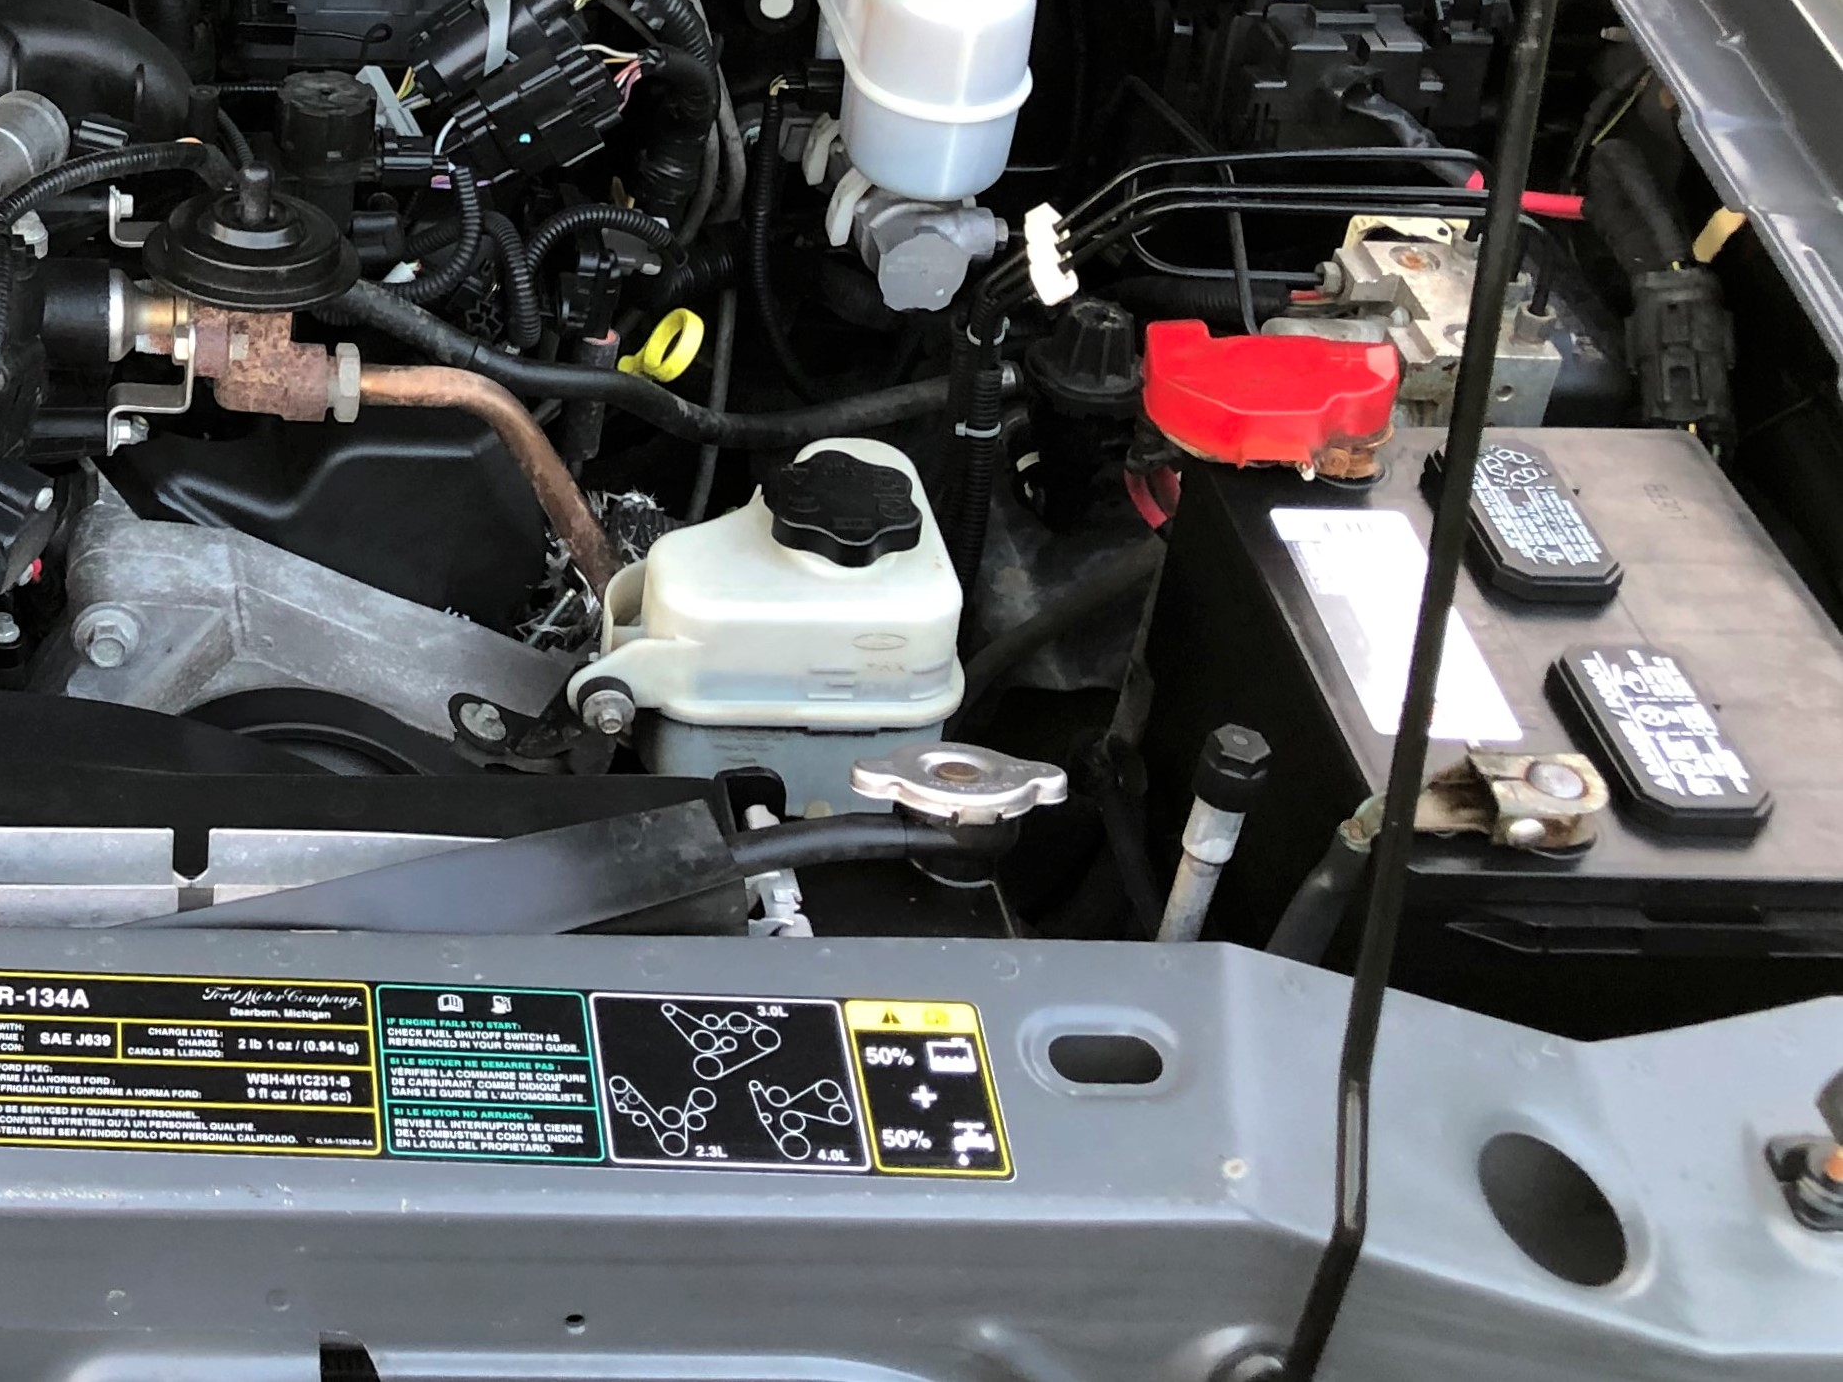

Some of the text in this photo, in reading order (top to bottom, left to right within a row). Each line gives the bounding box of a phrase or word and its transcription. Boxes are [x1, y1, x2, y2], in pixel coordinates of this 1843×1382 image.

[202, 987, 362, 1010] Ford Motor Company
[230, 1007, 331, 1021] Dearborn, Michigan
[757, 1004, 789, 1018] 3.0L
[399, 1018, 437, 1027] ENGINE
[439, 1020, 467, 1028] FAILS
[470, 1021, 484, 1029] TO
[40, 1032, 111, 1047] SAE J639
[148, 1027, 223, 1038] CHARGE LEVEL:
[387, 1027, 560, 1043] CHECK FUEL SHUTOFF SWITCH AS
[0, 1043, 24, 1052] CON:
[177, 1038, 218, 1048] CHARGE
[249, 1039, 262, 1050] lb
[276, 1041, 293, 1051] oz
[303, 1040, 335, 1053] (0.94
[338, 1041, 359, 1055] kg)
[388, 1037, 580, 1053] REFERENCED IN YOUR OWNER GUIDE.
[127, 1047, 224, 1058] CARGA DE LLENADO:
[865, 1046, 915, 1067] 50%
[24, 1064, 53, 1073] SPEC:
[390, 1057, 400, 1065] SI
[464, 1060, 478, 1068] NE
[534, 1062, 555, 1071] PAS
[32, 1075, 45, 1083] LA
[46, 1075, 81, 1085] NORME
[83, 1076, 110, 1085] FORD
[439, 1069, 454, 1078] LA
[455, 1069, 517, 1081] COMMANDE
[518, 1072, 534, 1081] DE
[535, 1072, 587, 1083] COUPURE
[391, 1077, 406, 1086] DE
[477, 1080, 516, 1090] COMME
[69, 1086, 124, 1096] CONFORME
[134, 1088, 170, 1098] NORMA
[171, 1089, 202, 1099] FORD:
[258, 1087, 268, 1099] fl
[271, 1090, 287, 1100] oz
[330, 1090, 352, 1104] cc)
[392, 1087, 422, 1097] DANS
[423, 1088, 437, 1098] LE
[439, 1088, 472, 1099] GUIDE
[474, 1090, 489, 1099] DE
[5, 1105, 18, 1114] BE
[20, 1105, 69, 1115] SERVICED
[70, 1107, 84, 1116] BY
[86, 1107, 138, 1118] QUALIFIED
[406, 1108, 419, 1116] LE
[422, 1109, 460, 1117] MOTOR
[462, 1110, 478, 1118] NO
[394, 1118, 583, 1134] REVISE EL INTERRUPTOR DE CIERRE
[29, 1126, 55, 1136] DEBE
[58, 1128, 78, 1137] SER
[79, 1128, 129, 1138] ATENDIDO
[130, 1130, 158, 1139] SOLO
[159, 1131, 181, 1140] POR
[182, 1132, 235, 1142] PERSONAL
[395, 1128, 584, 1144] DEL COMBUSTIBLE COMO SE INDICA
[881, 1129, 933, 1150] 50%
[395, 1138, 411, 1148] EN
[413, 1139, 428, 1149] LA
[457, 1140, 479, 1151] DEL
[480, 1141, 554, 1153] PROPIETARIO.
[695, 1146, 728, 1160] 2.3L
[817, 1149, 851, 1163] 4.0L
